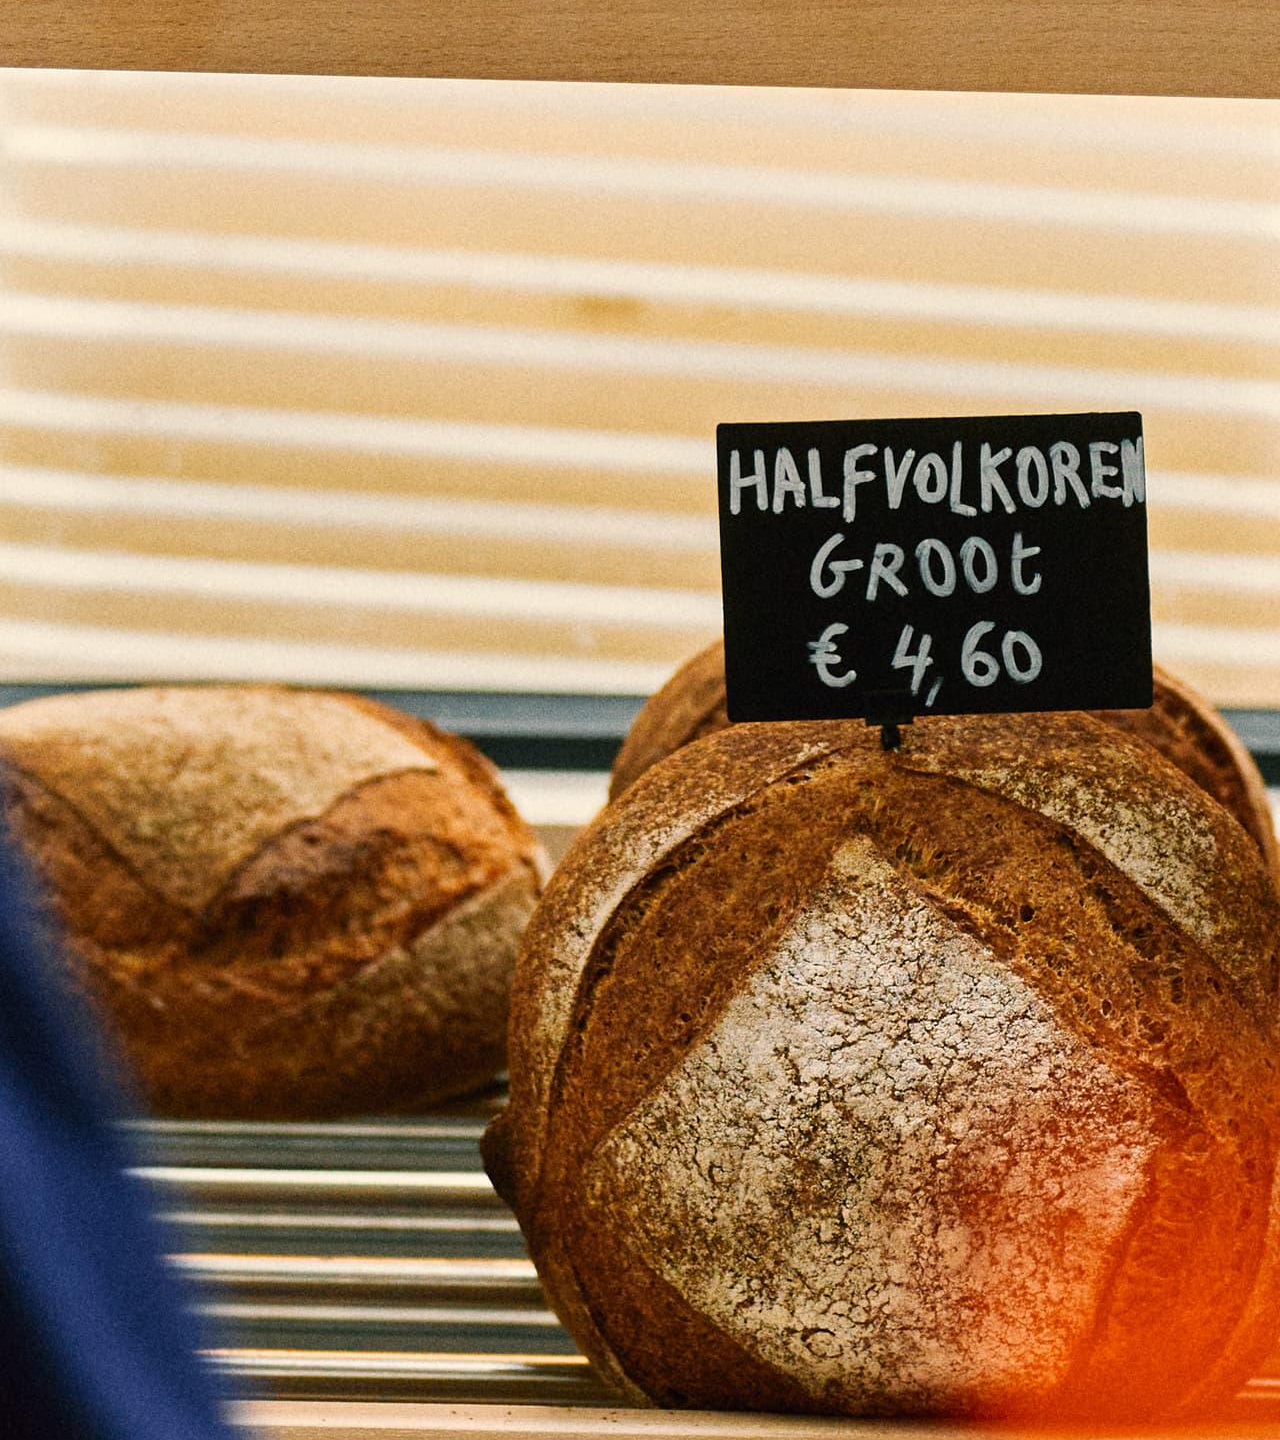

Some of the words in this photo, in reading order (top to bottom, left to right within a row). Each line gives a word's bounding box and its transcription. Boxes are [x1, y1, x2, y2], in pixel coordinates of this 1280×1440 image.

[729, 435, 1146, 523] HALFVOLKOREN
[806, 622, 858, 688] €
[891, 620, 1043, 708] 4,60
